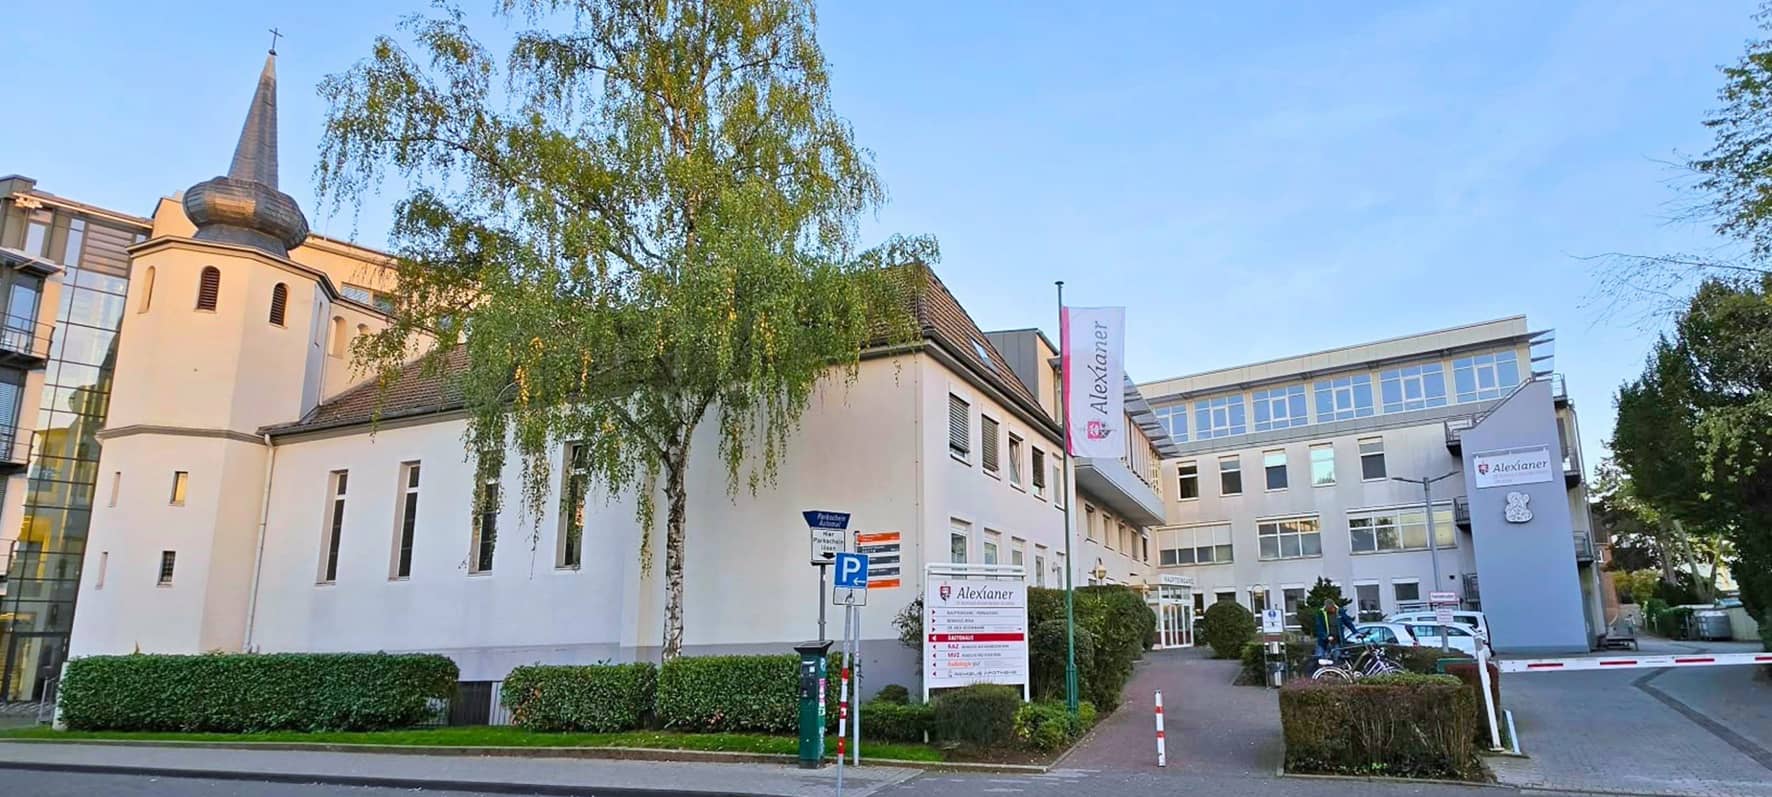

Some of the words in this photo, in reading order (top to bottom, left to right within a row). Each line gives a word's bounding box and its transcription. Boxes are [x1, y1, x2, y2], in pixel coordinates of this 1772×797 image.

[1087, 320, 1108, 415] Alexianer
[1493, 459, 1547, 473] Alexianer
[843, 556, 861, 582] P
[956, 585, 1014, 600] Alexianer
